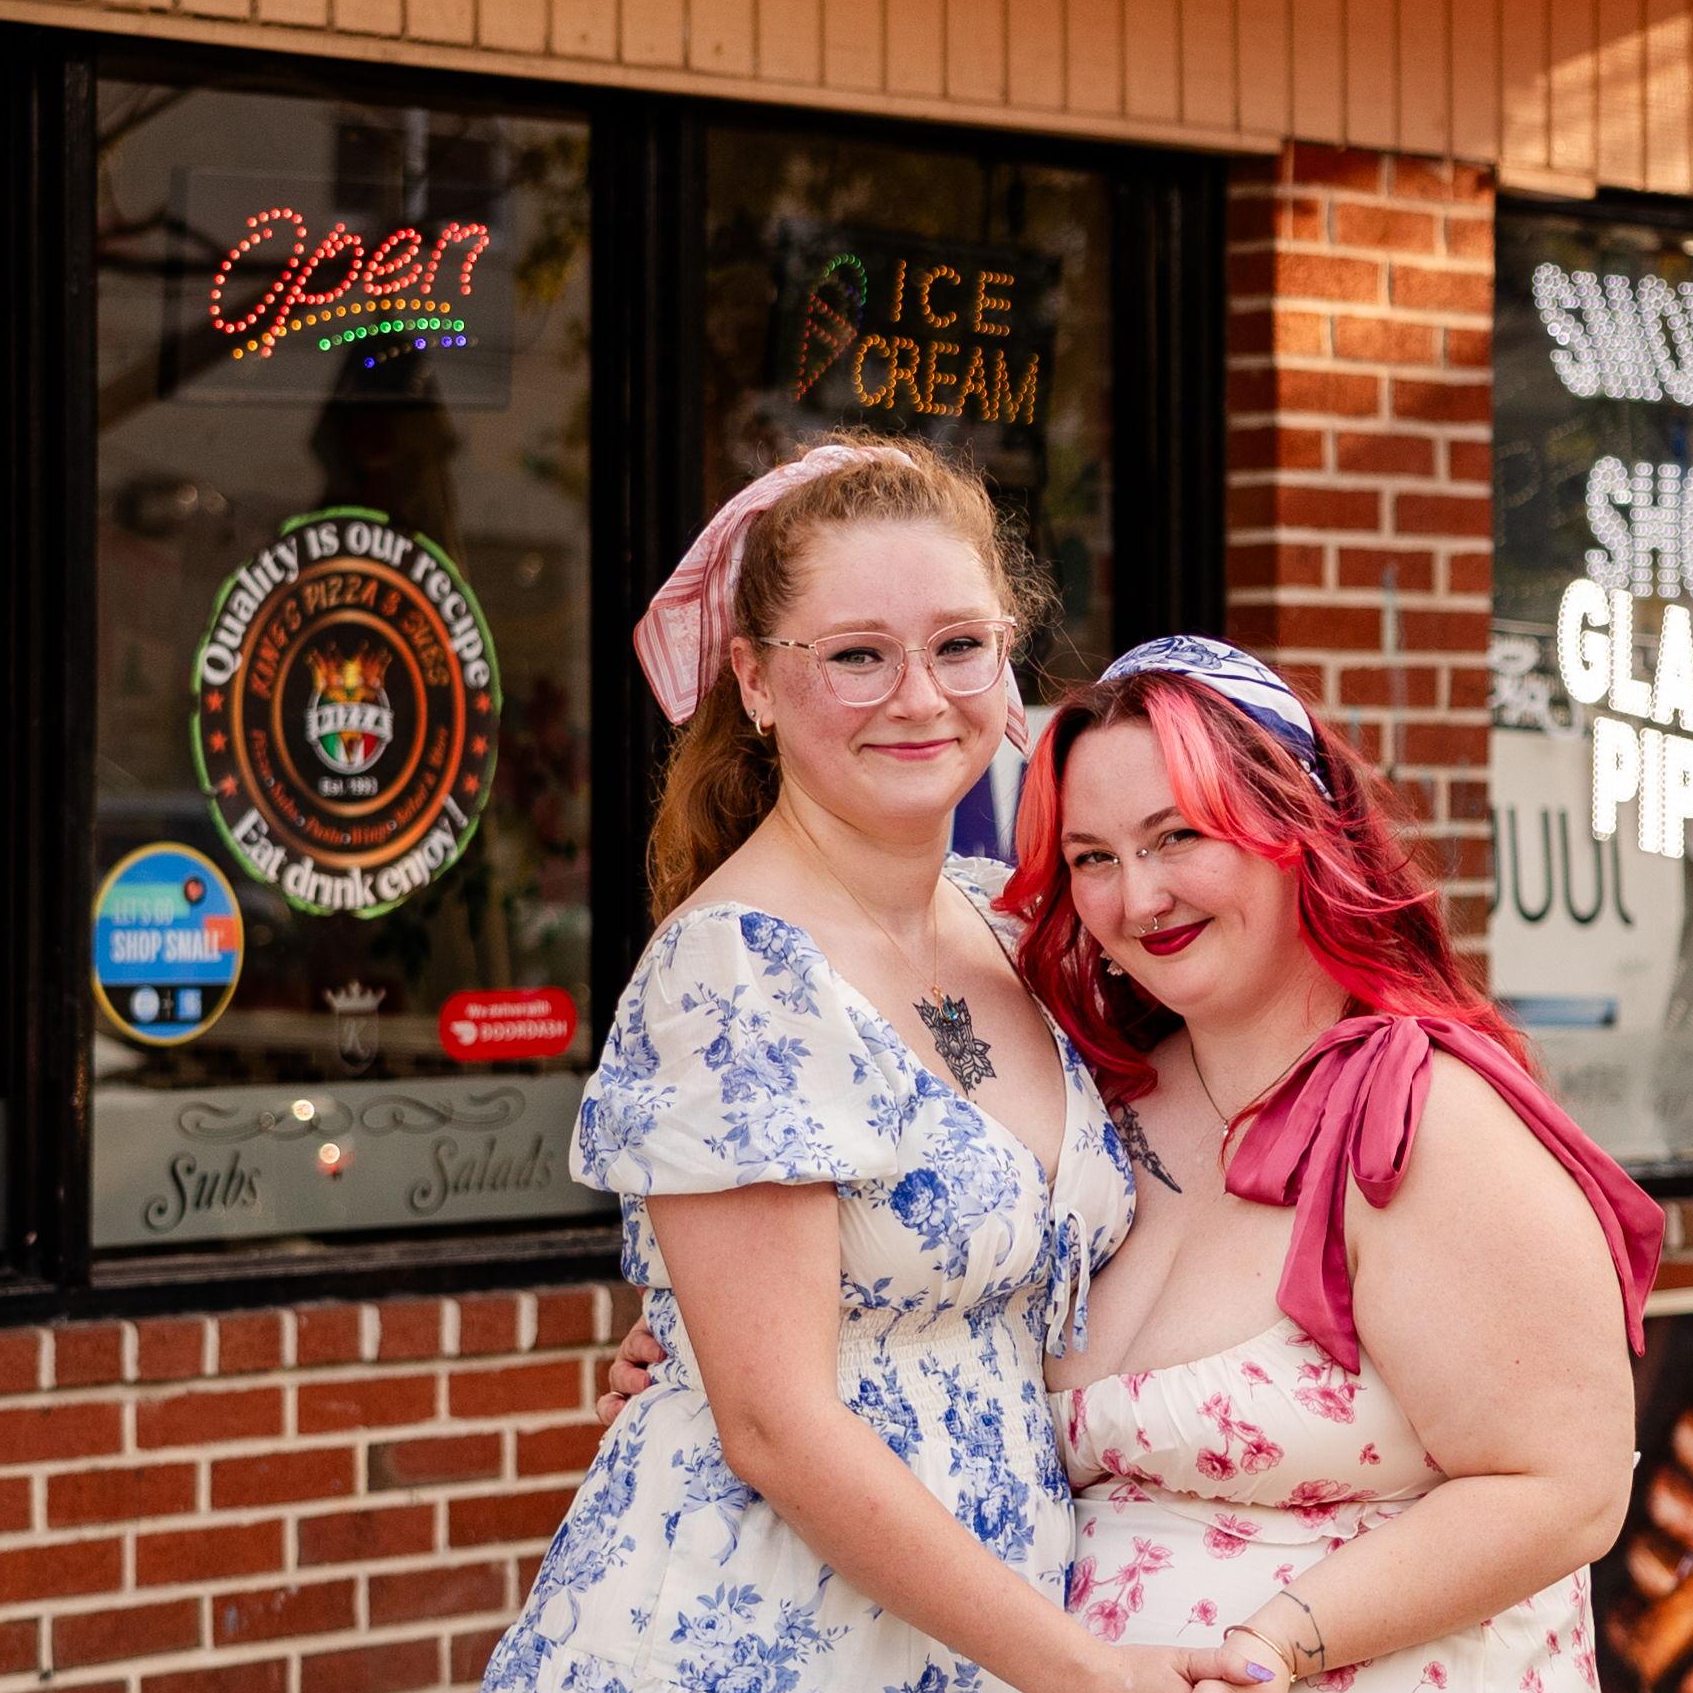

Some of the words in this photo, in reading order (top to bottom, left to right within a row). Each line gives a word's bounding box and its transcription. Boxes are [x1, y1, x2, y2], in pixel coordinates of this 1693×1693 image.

[210, 207, 490, 358] Open
[892, 258, 1016, 337] ICE
[854, 334, 1040, 425] CREAM
[202, 536, 300, 686] Quality
[304, 521, 340, 561] is
[344, 520, 414, 569] our
[410, 550, 491, 690] recipe
[303, 574, 379, 616] PIZZA
[232, 807, 288, 884] Eat
[281, 856, 378, 910] drink
[111, 929, 162, 964] SHOP
[164, 928, 223, 963] SMALL
[480, 1019, 568, 1043] DOORDASH
[142, 1149, 263, 1236] Subs
[408, 1132, 555, 1218] Salads
